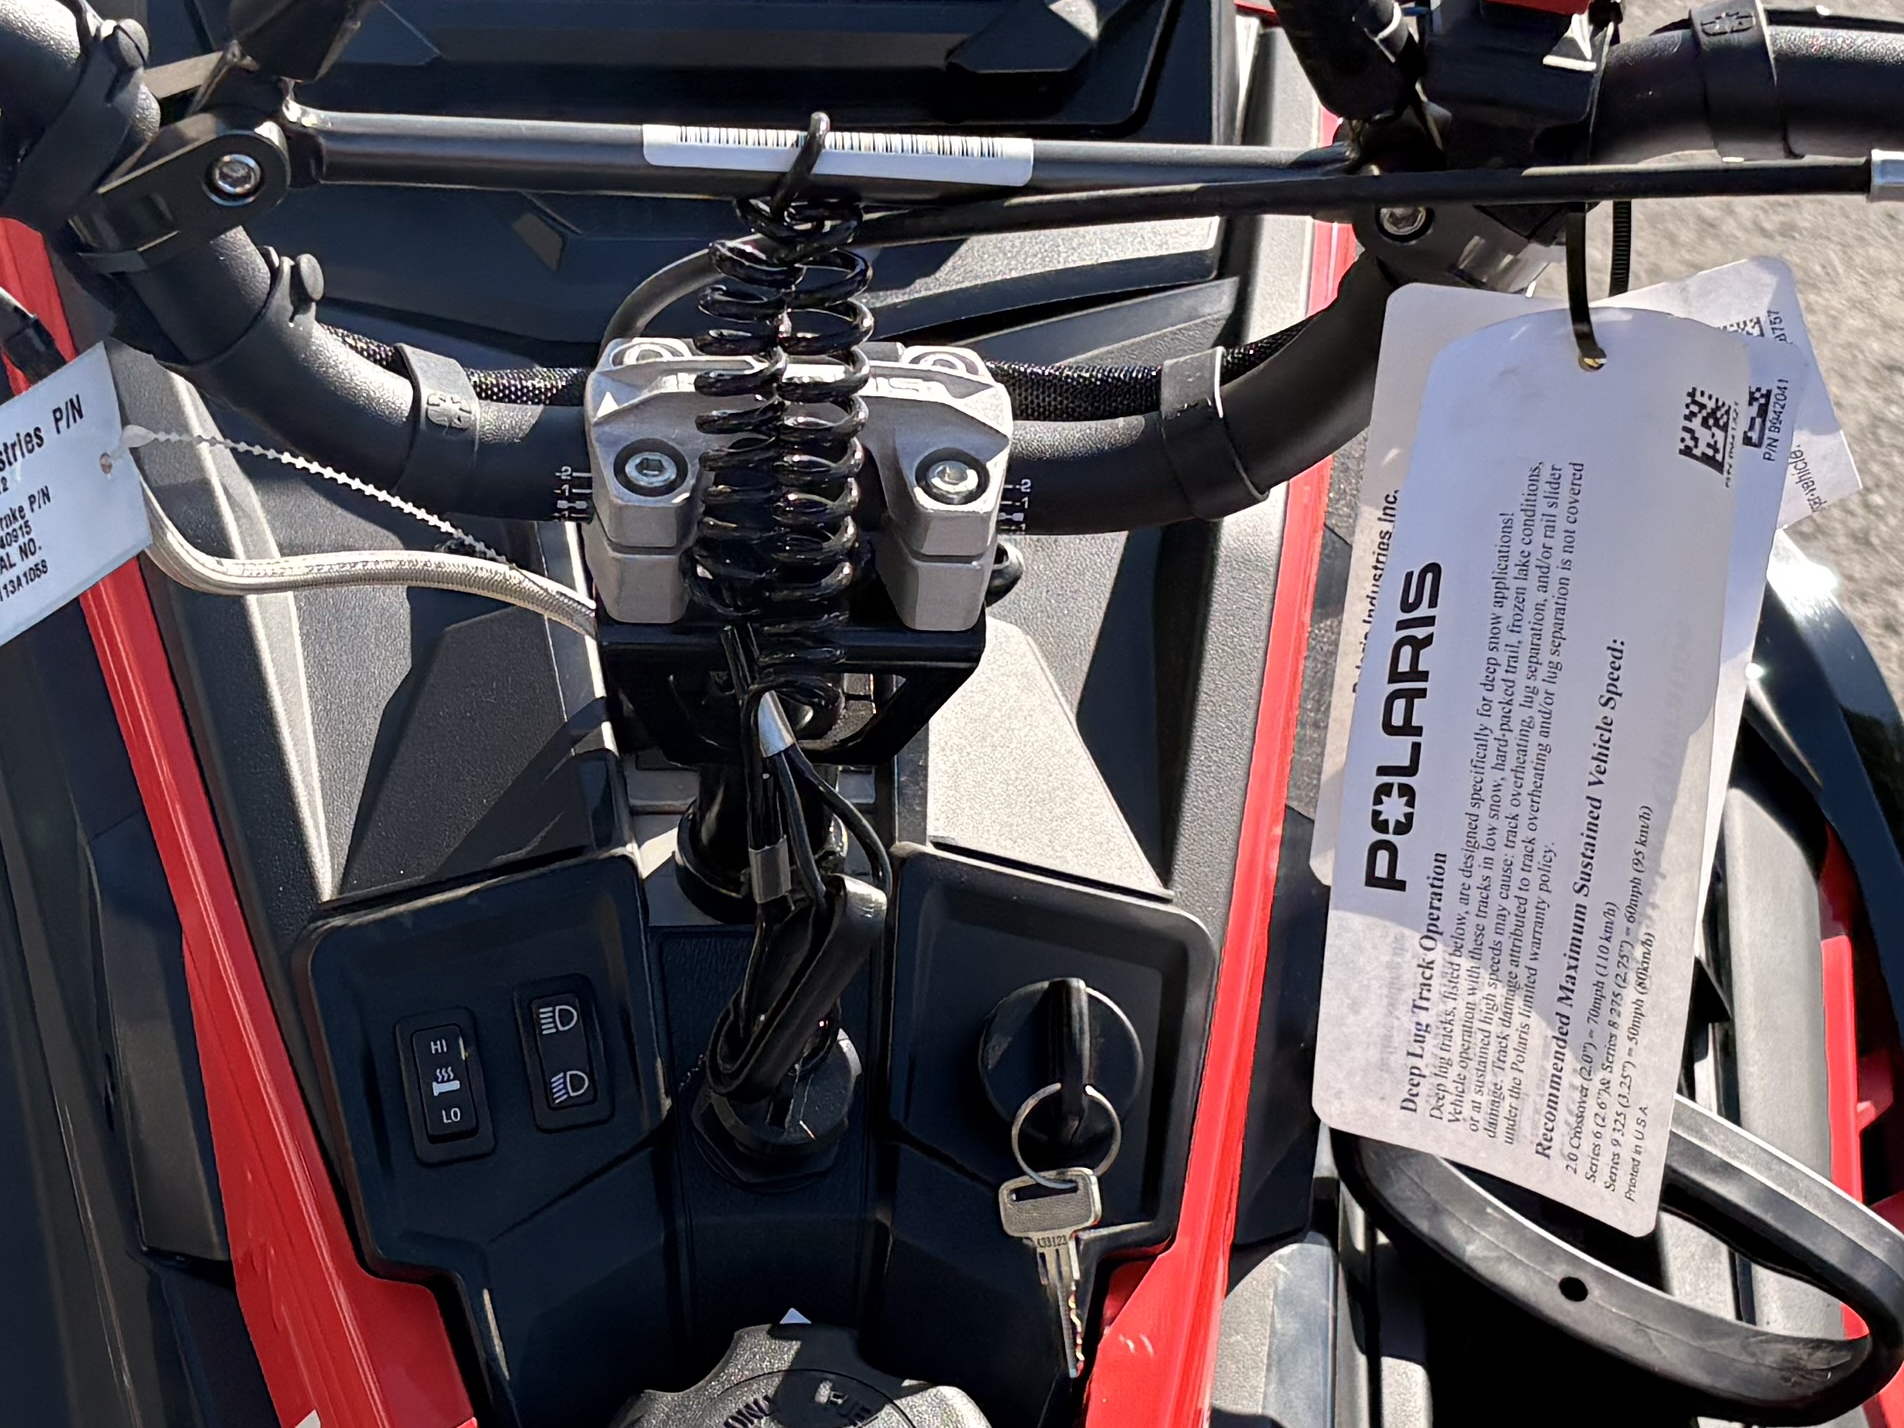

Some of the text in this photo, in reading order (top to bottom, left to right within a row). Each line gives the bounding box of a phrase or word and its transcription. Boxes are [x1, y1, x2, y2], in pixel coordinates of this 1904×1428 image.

[52, 393, 85, 435] P/N
[1762, 436, 1780, 462] P/N
[561, 465, 572, 480] 2
[561, 484, 570, 497] 1
[1020, 478, 1032, 493] 2
[27, 485, 51, 514] P/N
[1021, 496, 1029, 509] 1
[18, 537, 42, 562] NO.
[1364, 561, 1443, 893] POLARIS
[1429, 512, 1515, 1121] Deep lug tracks, listed below, are designed specifically for deep snow applications!
[1534, 639, 1625, 1160] Recommended Maximum Sustained Vehicle Speed:
[1399, 852, 1448, 1113] Deep Lug Track Operation
[430, 1038, 448, 1055] HI
[441, 1107, 462, 1124] LO
